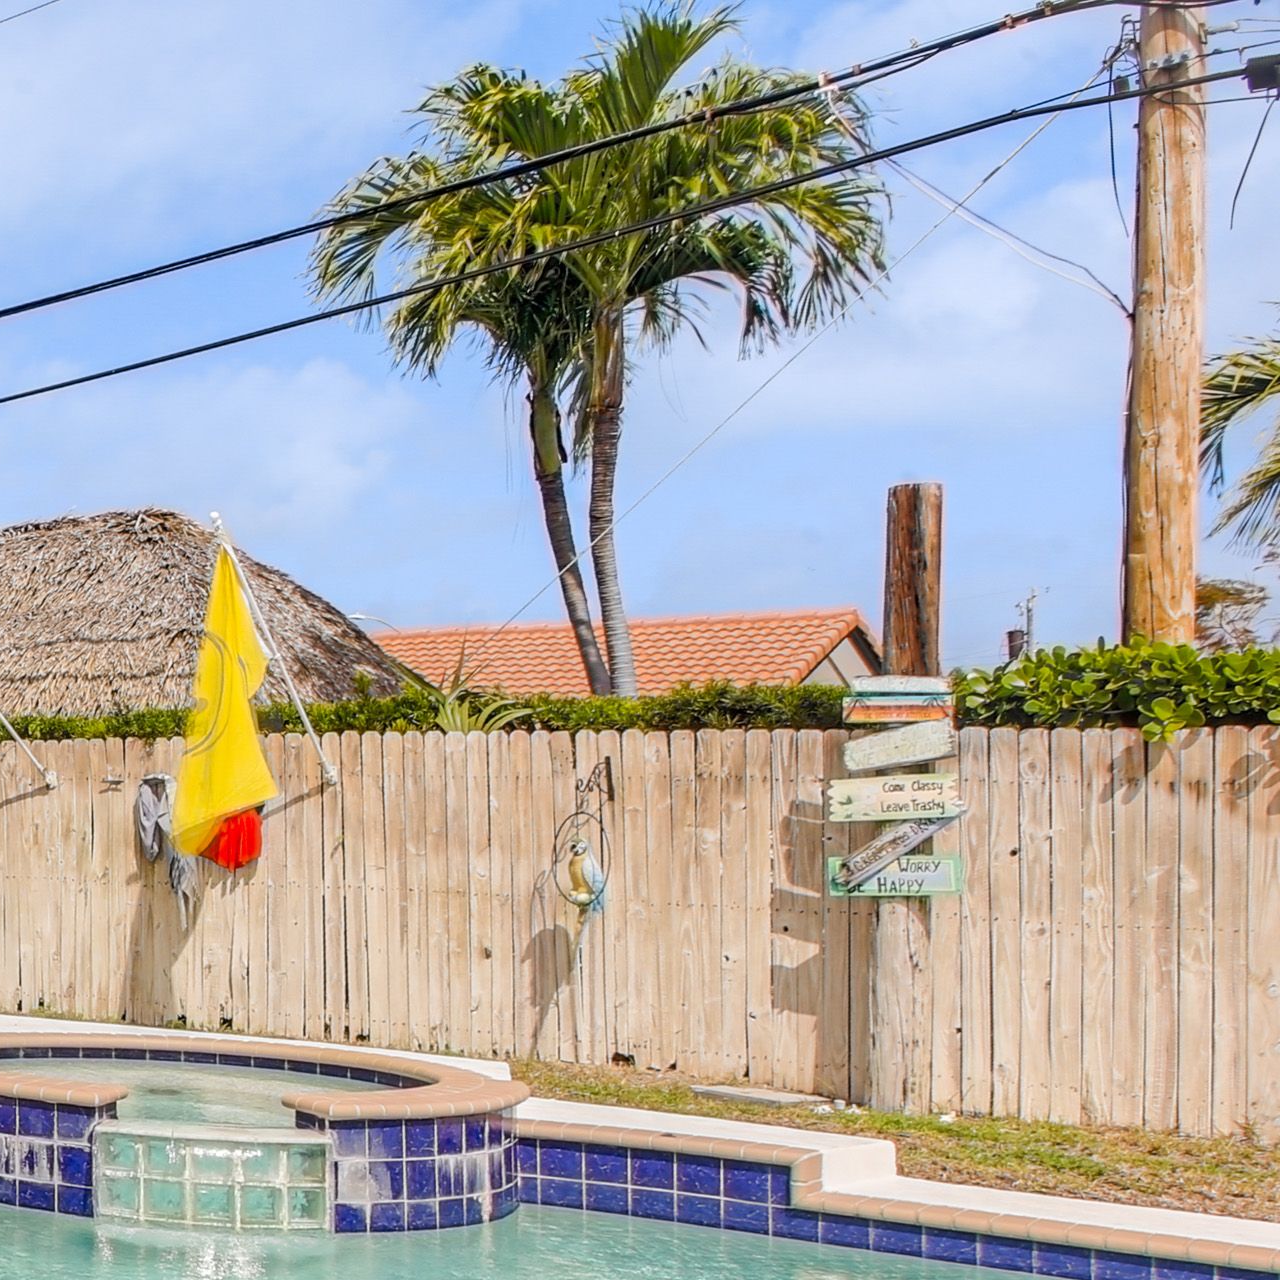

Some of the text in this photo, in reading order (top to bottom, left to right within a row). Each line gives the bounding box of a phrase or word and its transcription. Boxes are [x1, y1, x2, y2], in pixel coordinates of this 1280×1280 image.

[882, 780, 943, 795] Come Classy
[880, 799, 945, 815] Leave Trashy
[897, 859, 941, 873] WORRY
[877, 877, 924, 893] HAPPY
